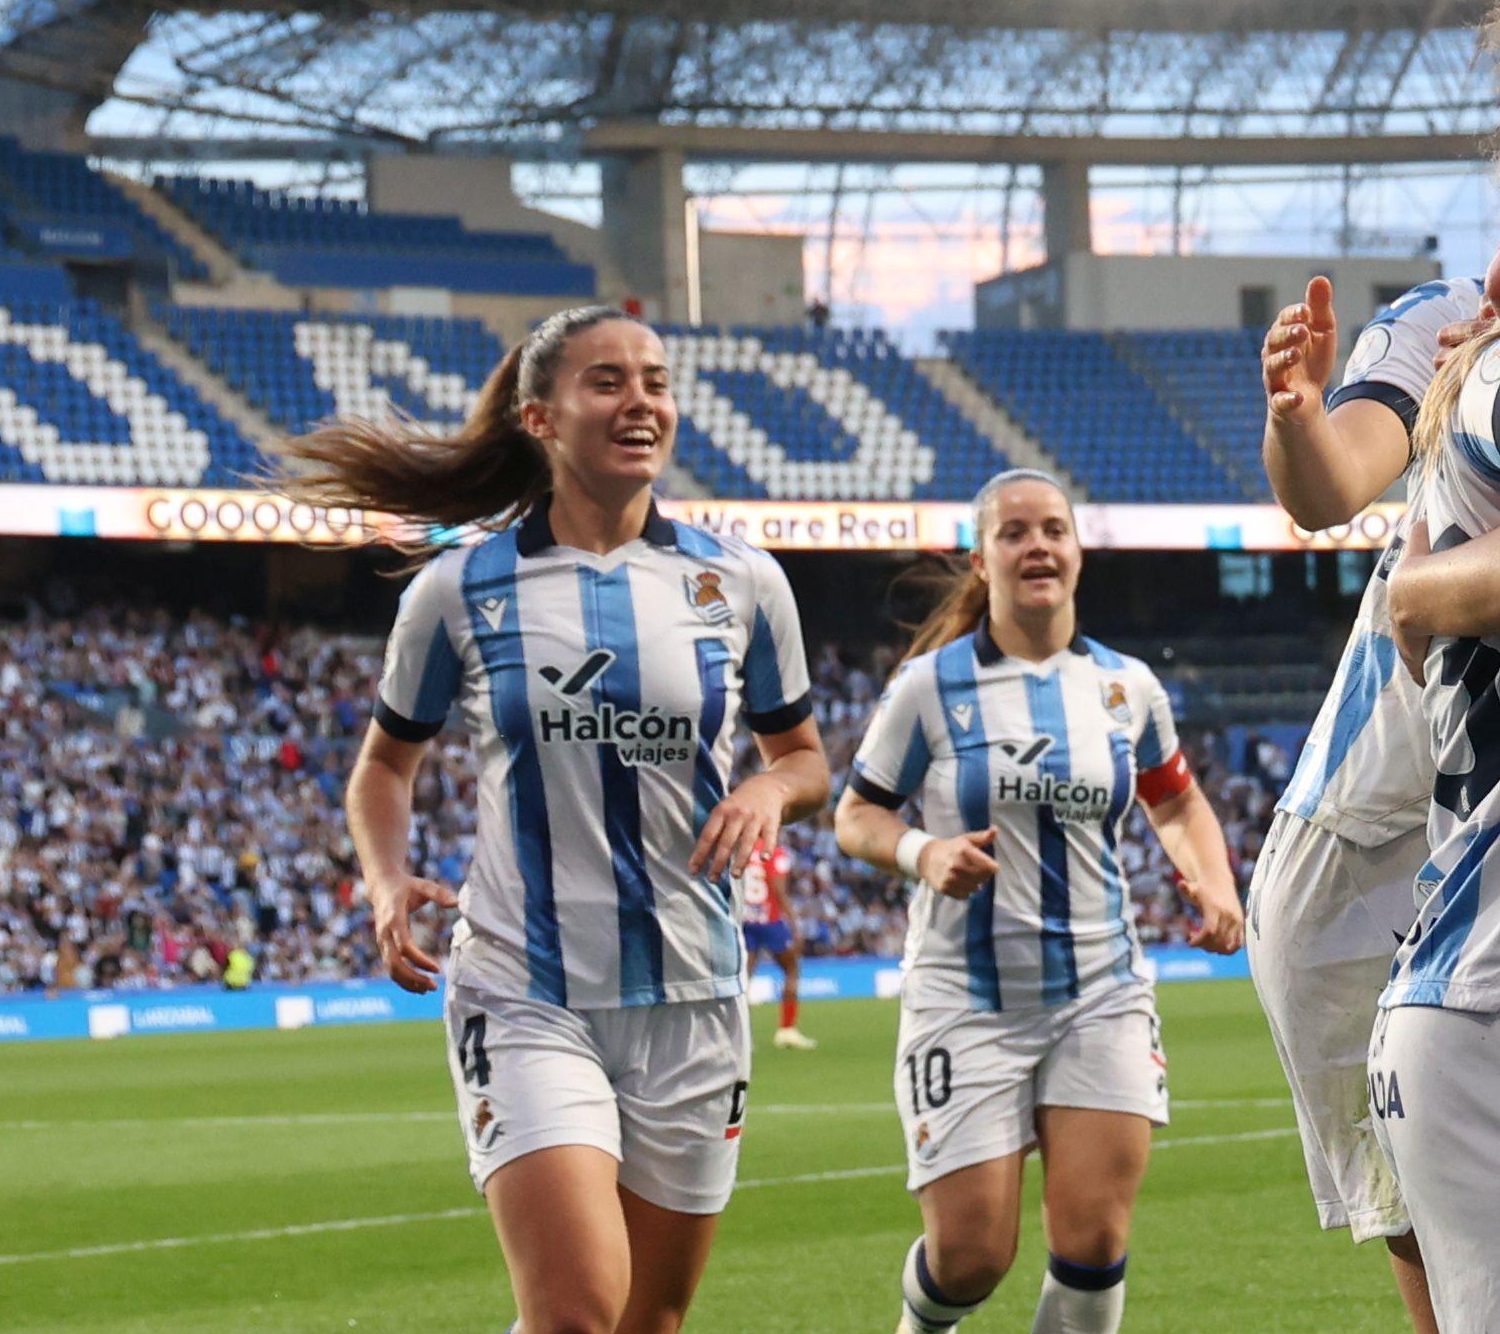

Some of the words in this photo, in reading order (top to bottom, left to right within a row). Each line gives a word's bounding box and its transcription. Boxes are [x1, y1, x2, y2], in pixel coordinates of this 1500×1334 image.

[762, 515, 826, 539] are
[838, 511, 918, 541] Real
[541, 703, 692, 743] Halcón
[620, 742, 689, 765] viajes
[998, 777, 1108, 805] Halcón
[458, 1014, 493, 1087] 4
[904, 1047, 952, 1116] 10
